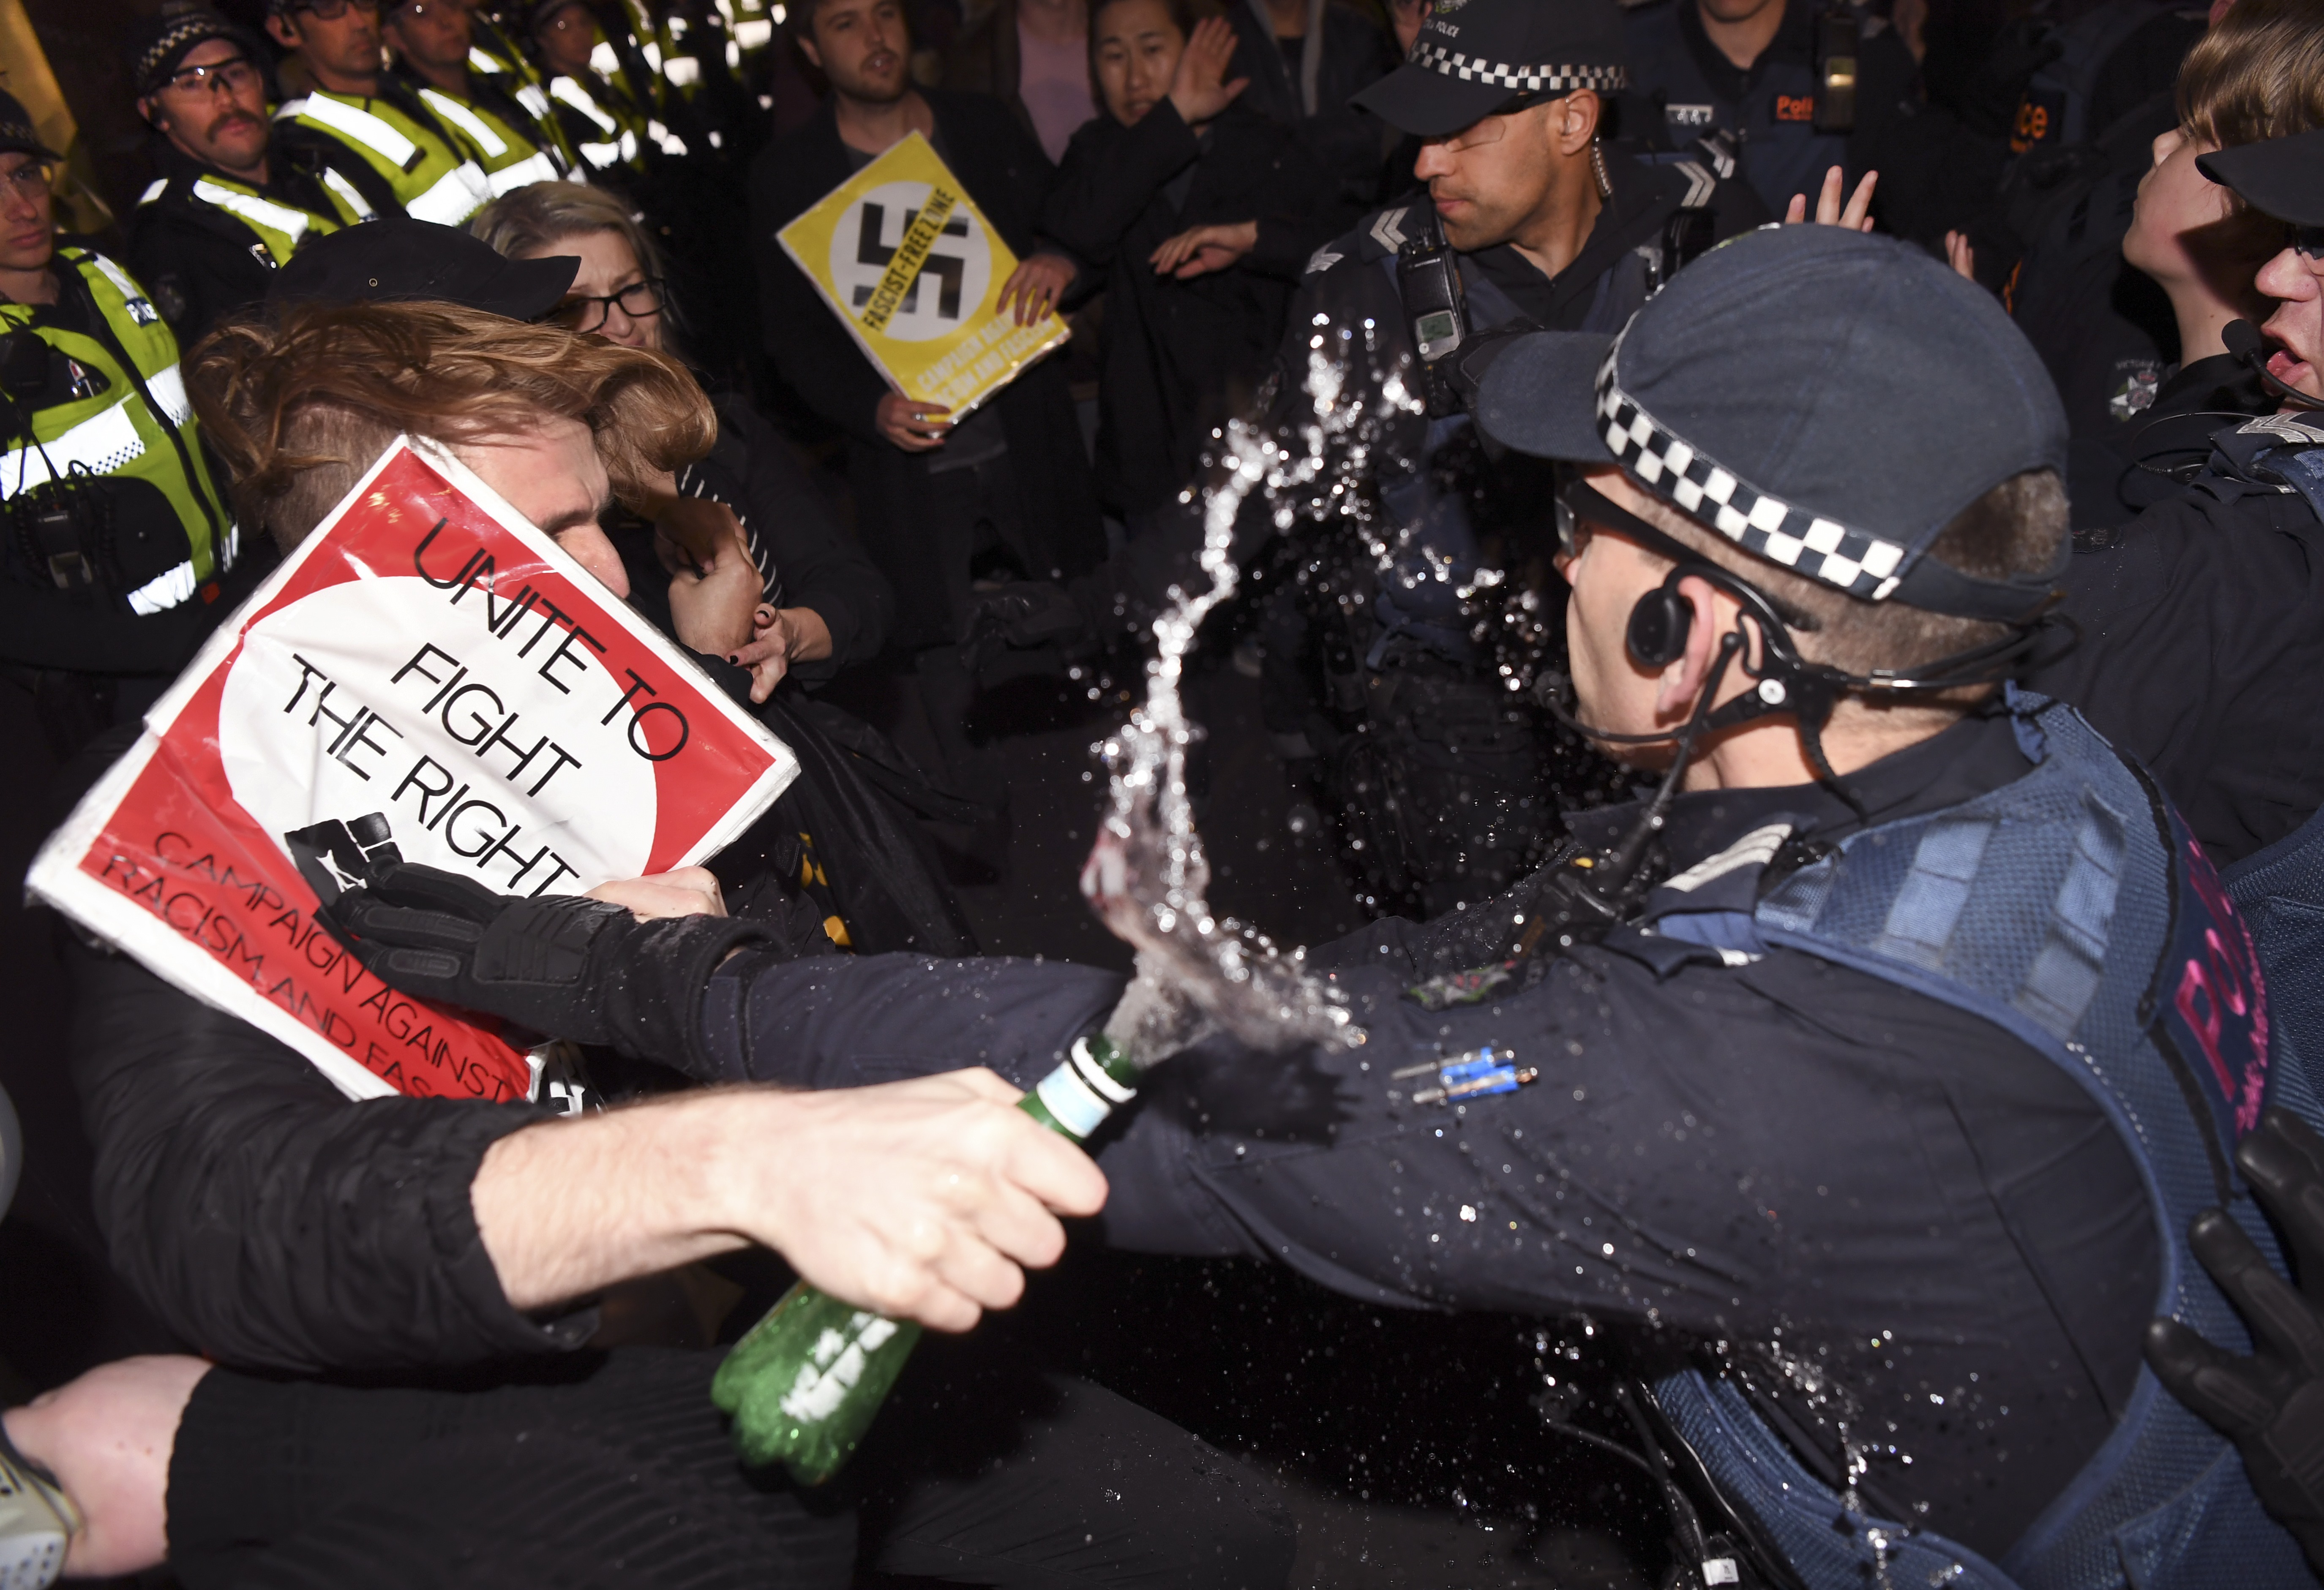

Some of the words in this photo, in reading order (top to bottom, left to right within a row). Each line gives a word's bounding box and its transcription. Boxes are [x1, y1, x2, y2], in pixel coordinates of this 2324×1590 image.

[390, 642, 582, 798] FIGHT
[414, 517, 608, 696] UNITE
[600, 668, 689, 762] TO
[283, 653, 404, 782] THE
[390, 754, 580, 897] RIGHT
[101, 854, 264, 980] RACISM
[269, 977, 357, 1048] AND
[154, 832, 368, 994] CAMPAIGN
[360, 984, 507, 1103] AGAINST
